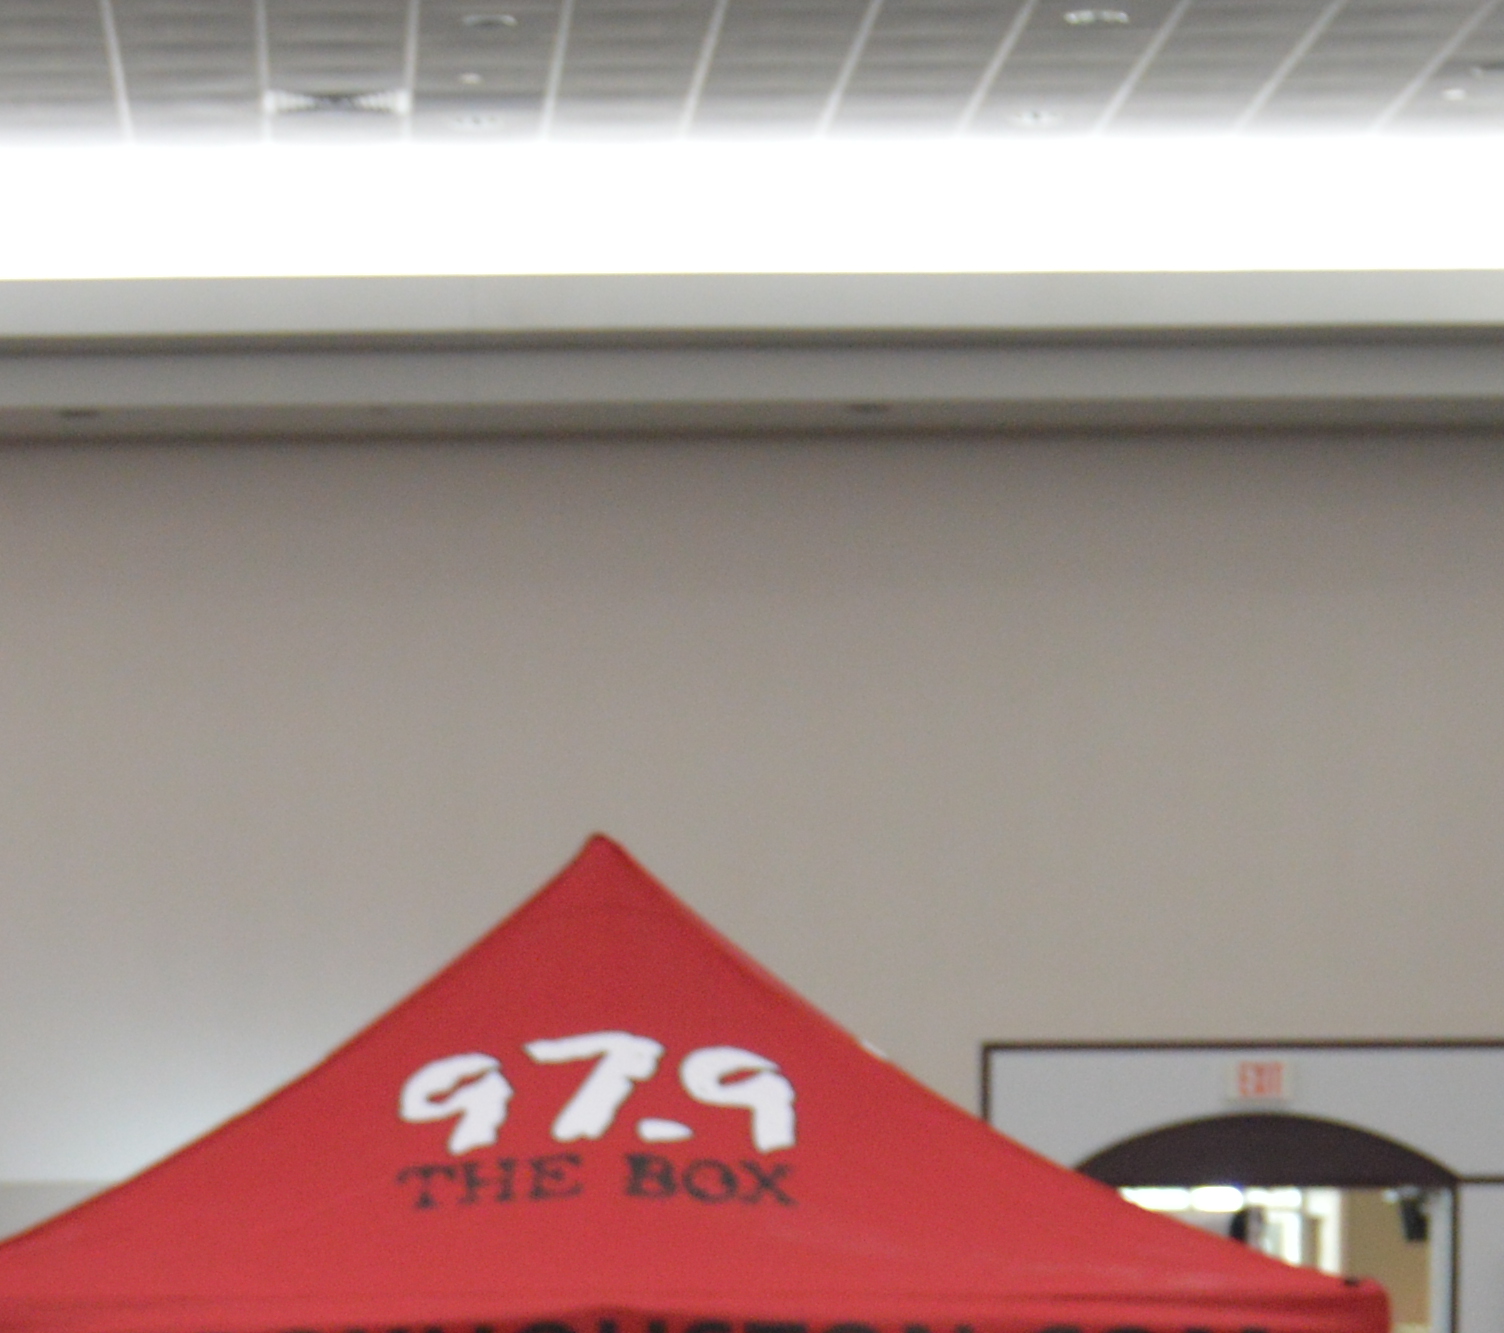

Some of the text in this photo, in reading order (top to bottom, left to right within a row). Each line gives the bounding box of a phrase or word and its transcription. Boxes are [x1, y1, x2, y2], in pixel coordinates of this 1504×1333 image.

[399, 1030, 796, 1155] 97.9
[1238, 1060, 1284, 1097] EXIT
[397, 1152, 798, 1210] THE BOX
